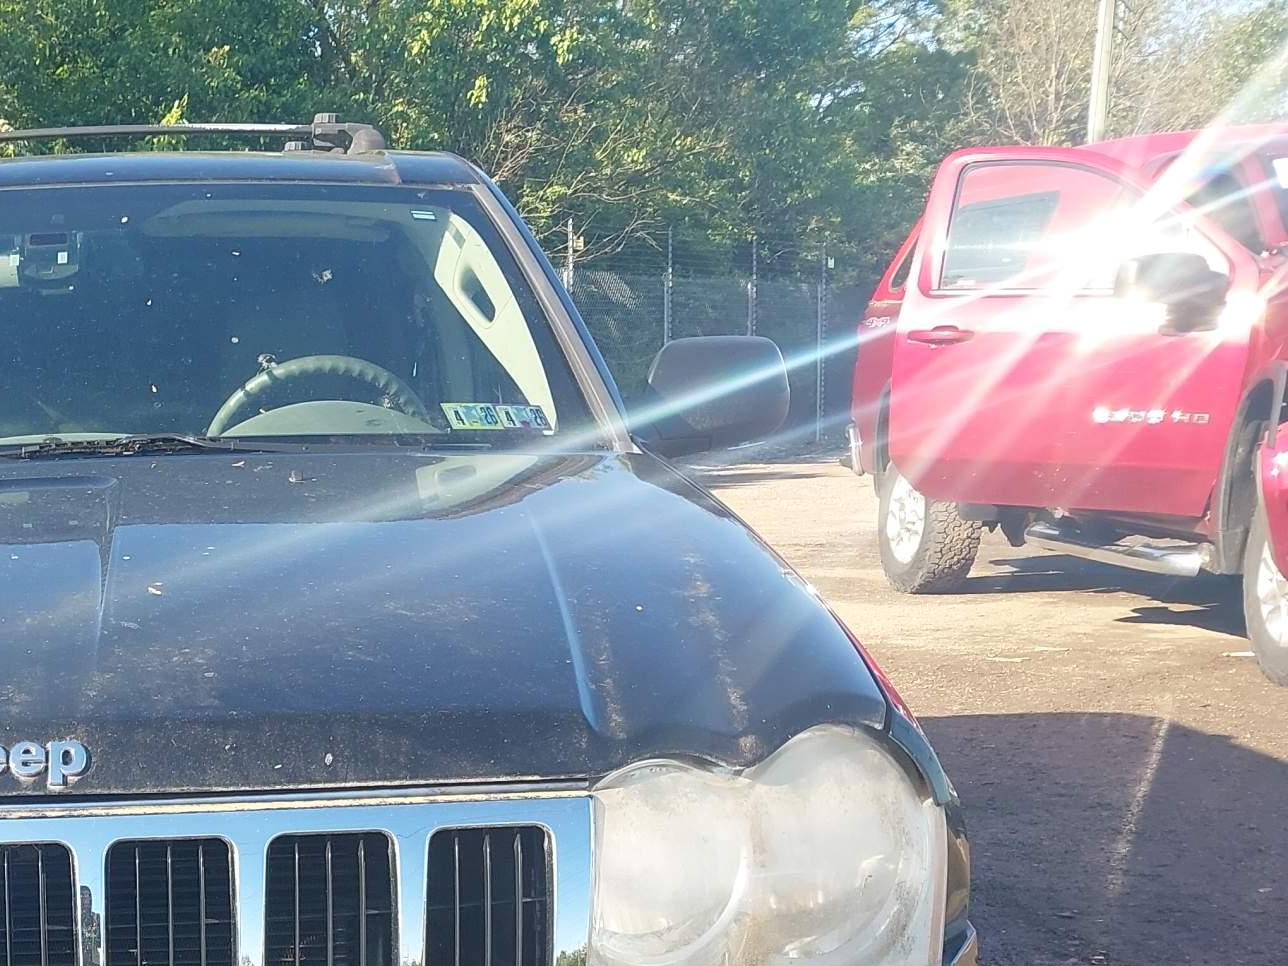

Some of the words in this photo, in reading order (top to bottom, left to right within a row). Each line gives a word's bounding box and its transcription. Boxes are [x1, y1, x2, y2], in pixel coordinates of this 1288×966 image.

[453, 409, 466, 426] 4
[479, 406, 499, 425] 26
[503, 410, 516, 427] 4
